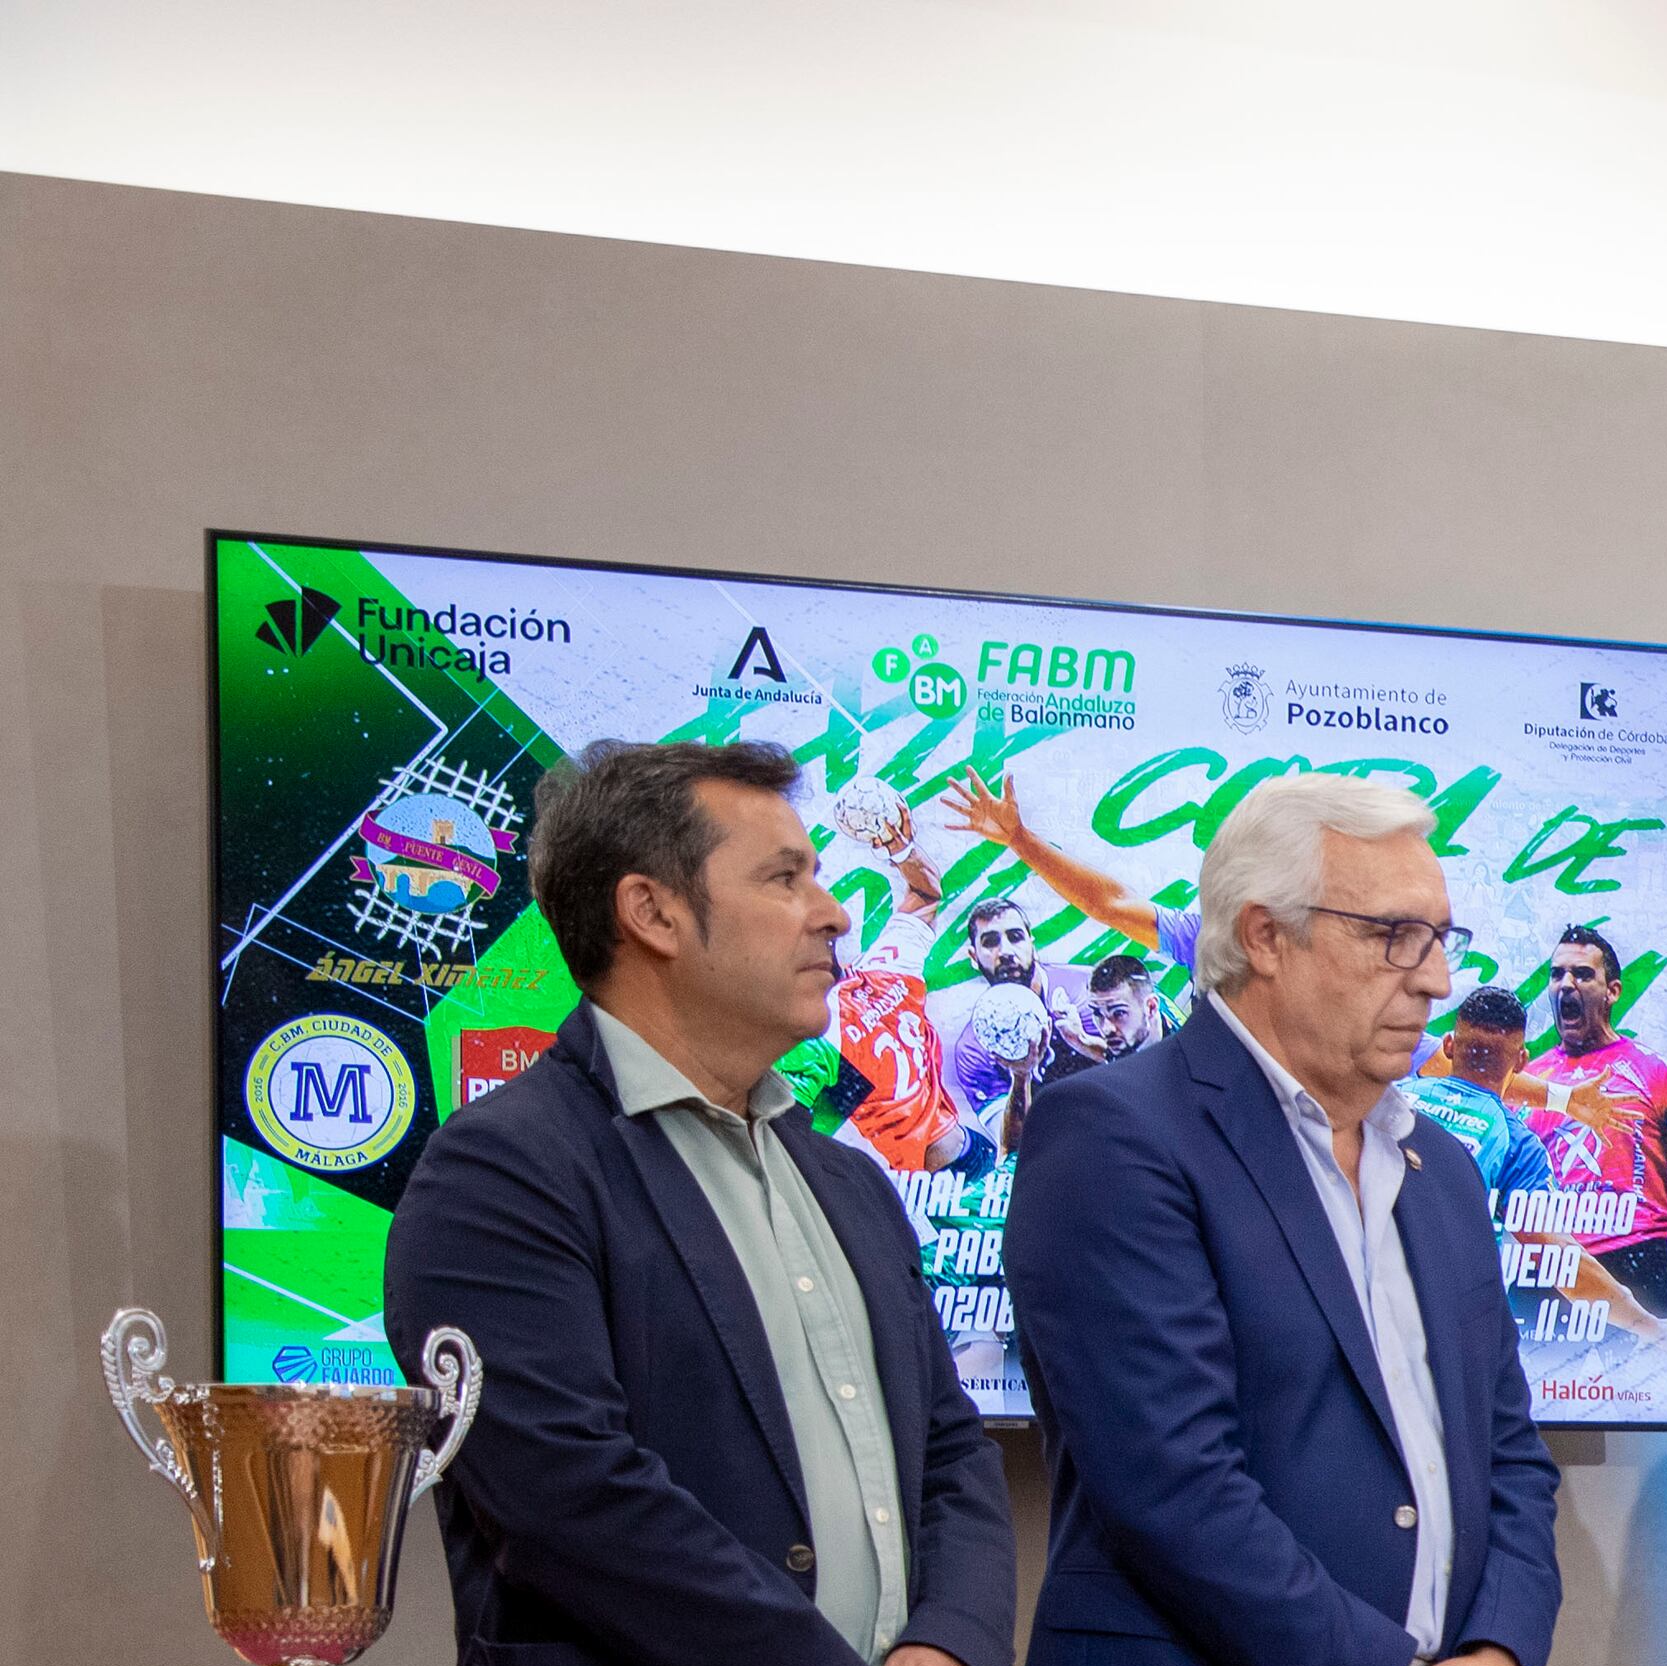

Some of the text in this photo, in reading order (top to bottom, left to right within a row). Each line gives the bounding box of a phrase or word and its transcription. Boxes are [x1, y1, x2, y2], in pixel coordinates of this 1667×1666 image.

[358, 597, 571, 643] Fundación
[359, 634, 511, 683] Unicaja
[977, 640, 1137, 693] FABM
[692, 683, 822, 705] Junta de Andalucía
[913, 676, 962, 708] BM
[977, 687, 1136, 716] Federación Andaluza
[1285, 680, 1448, 706] Ayuntamiento de
[978, 704, 1136, 731] de Balonmano
[1287, 702, 1449, 735] Pozoblanco
[1524, 722, 1596, 740] Diputación
[1598, 728, 1614, 741] de
[1502, 804, 1667, 895] DE
[312, 1019, 374, 1047] CIUDAD
[372, 1038, 393, 1058] DE
[295, 1148, 369, 1167] MÁLAGA
[321, 1347, 373, 1367] GRUPO
[321, 1367, 395, 1385] FAJARDO
[1541, 1375, 1652, 1403] Halcón VIAJES
